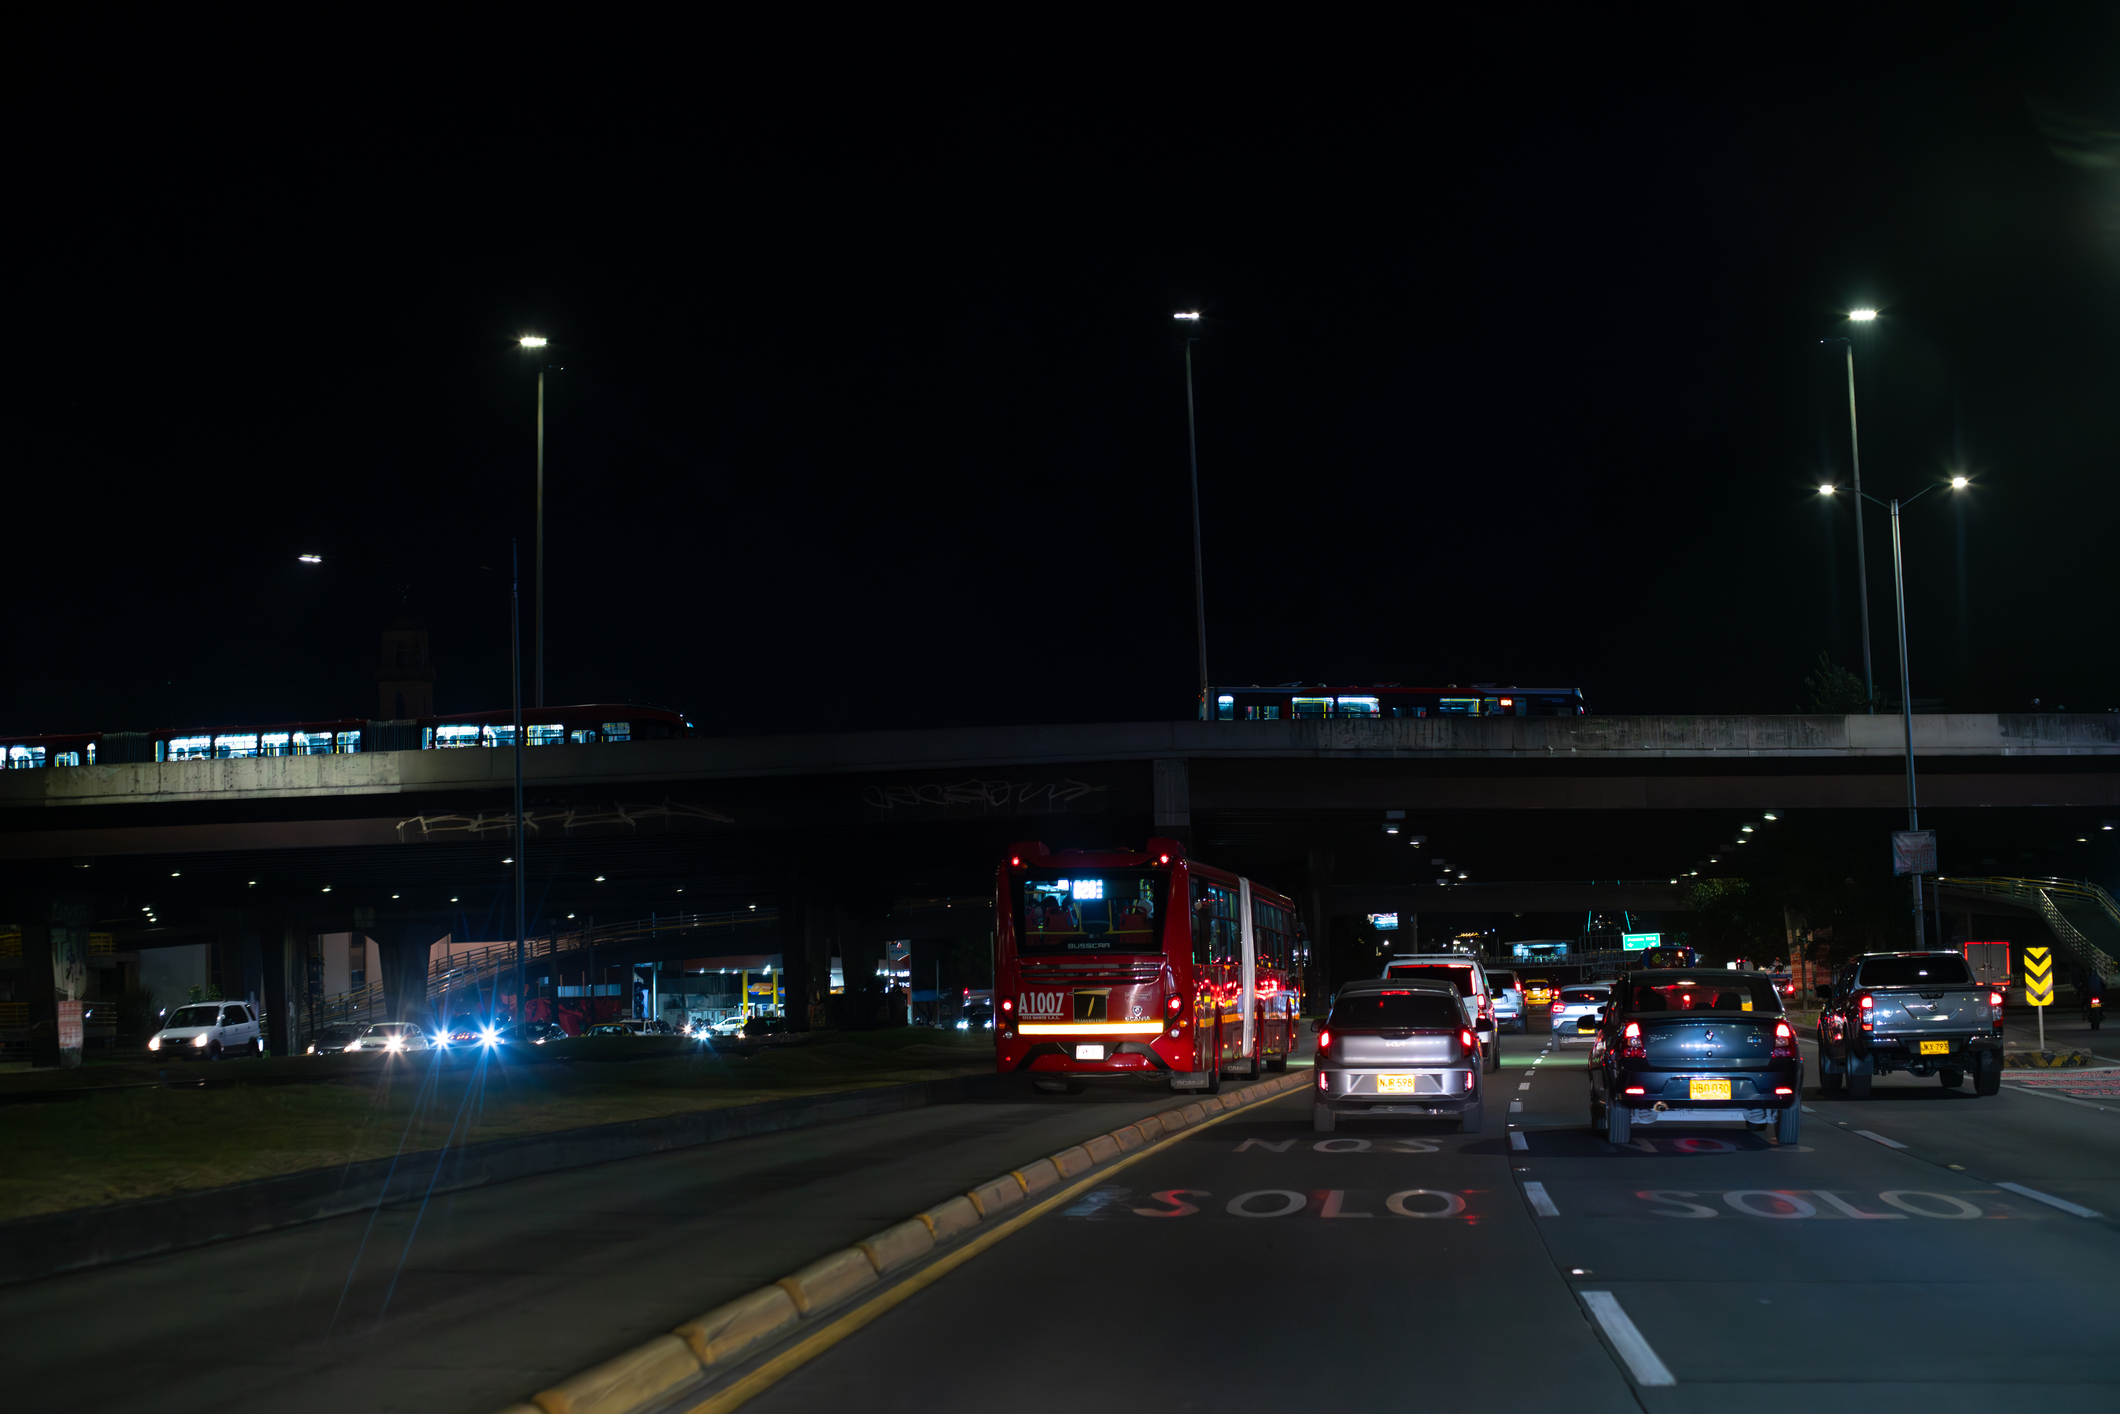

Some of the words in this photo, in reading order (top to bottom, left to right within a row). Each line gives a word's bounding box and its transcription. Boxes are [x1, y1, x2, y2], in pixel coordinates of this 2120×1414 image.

[1018, 992, 1064, 1013] A1007
[1232, 1138, 1444, 1153] NQS
[1132, 1189, 1467, 1218] SOLO
[1634, 1189, 1983, 1219] SOLO
